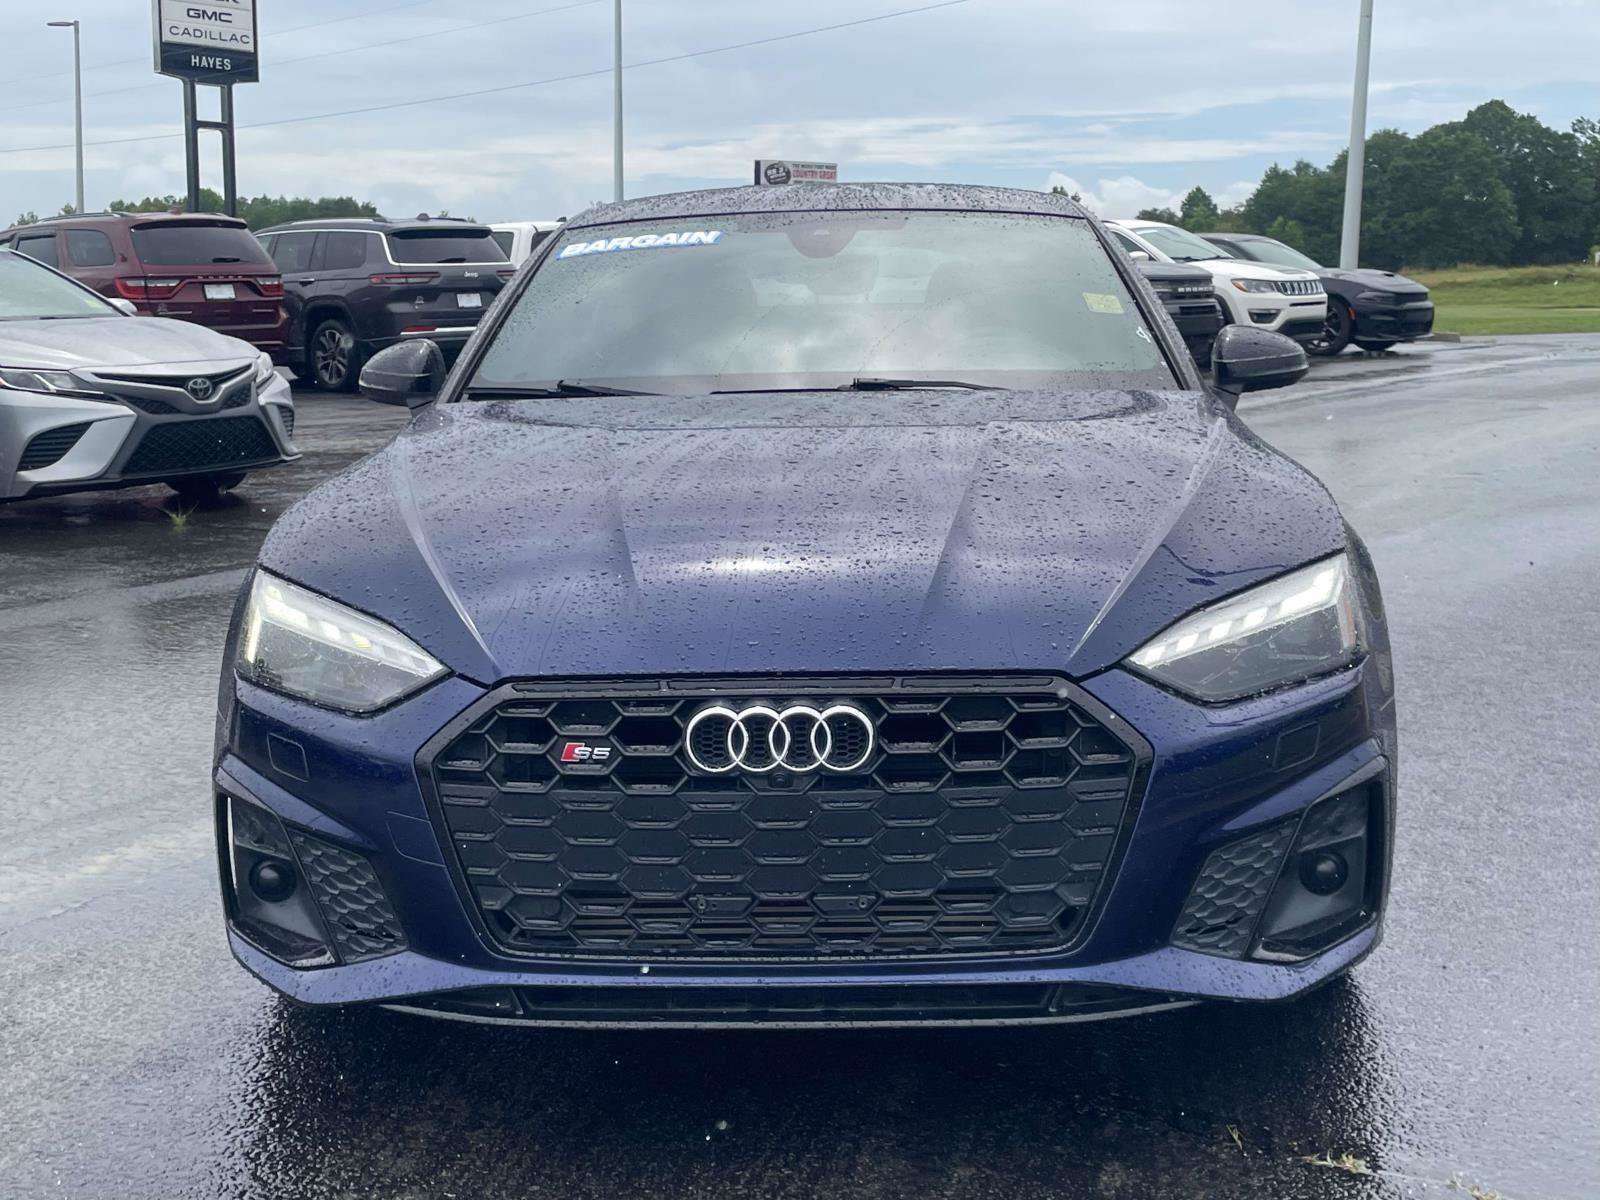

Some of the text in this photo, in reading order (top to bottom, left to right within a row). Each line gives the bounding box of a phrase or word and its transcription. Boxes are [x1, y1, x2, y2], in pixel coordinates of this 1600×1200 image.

[187, 8, 232, 23] GMC
[169, 25, 250, 44] CADILLAC
[191, 55, 231, 71] HAYES
[559, 231, 721, 258] BARGAIN
[570, 746, 612, 760] S5
